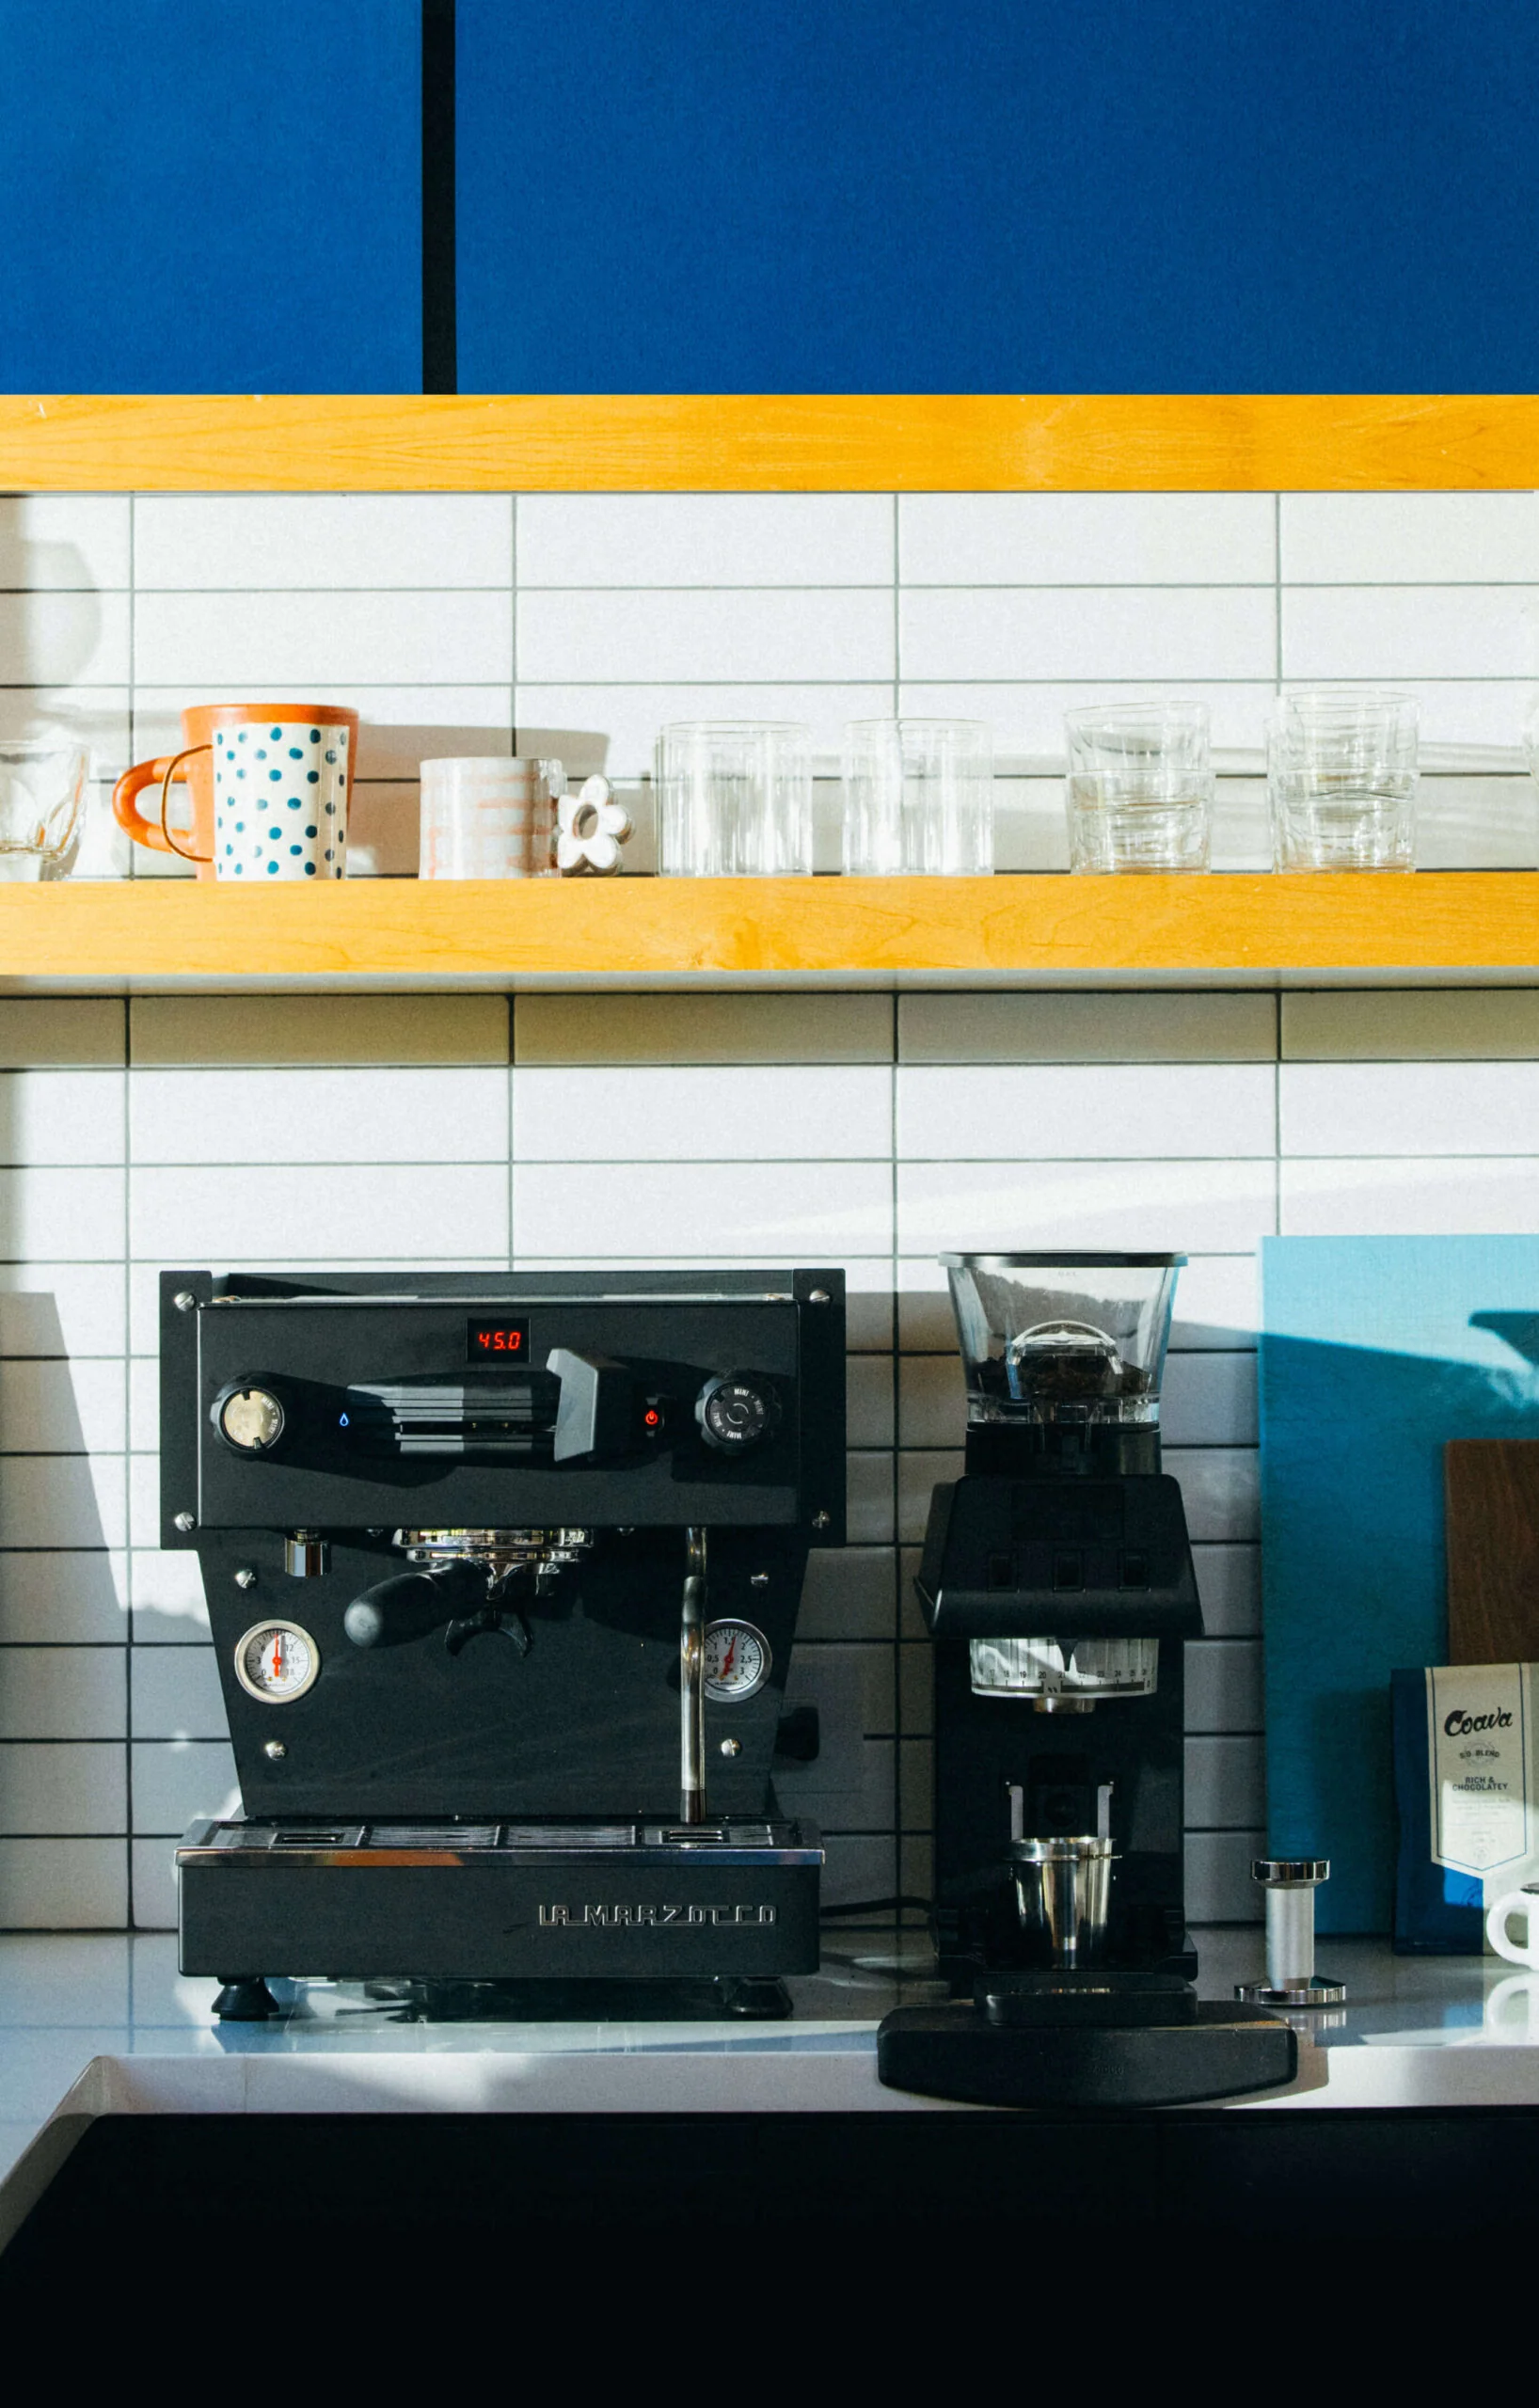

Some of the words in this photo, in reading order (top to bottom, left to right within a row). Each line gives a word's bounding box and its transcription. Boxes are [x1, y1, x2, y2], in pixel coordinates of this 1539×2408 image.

[478, 1331, 521, 1350] 45.0
[285, 1643, 294, 1653] 12
[706, 1655, 720, 1664] 0,5
[739, 1656, 753, 1664] 2,5
[1019, 1671, 1027, 1679] 19
[1038, 1671, 1047, 1679] 20
[1444, 1706, 1514, 1737] Coava
[1465, 1776, 1486, 1784] RICH
[1452, 1782, 1508, 1792] CHOCOLATEY
[539, 1905, 569, 1926] LA
